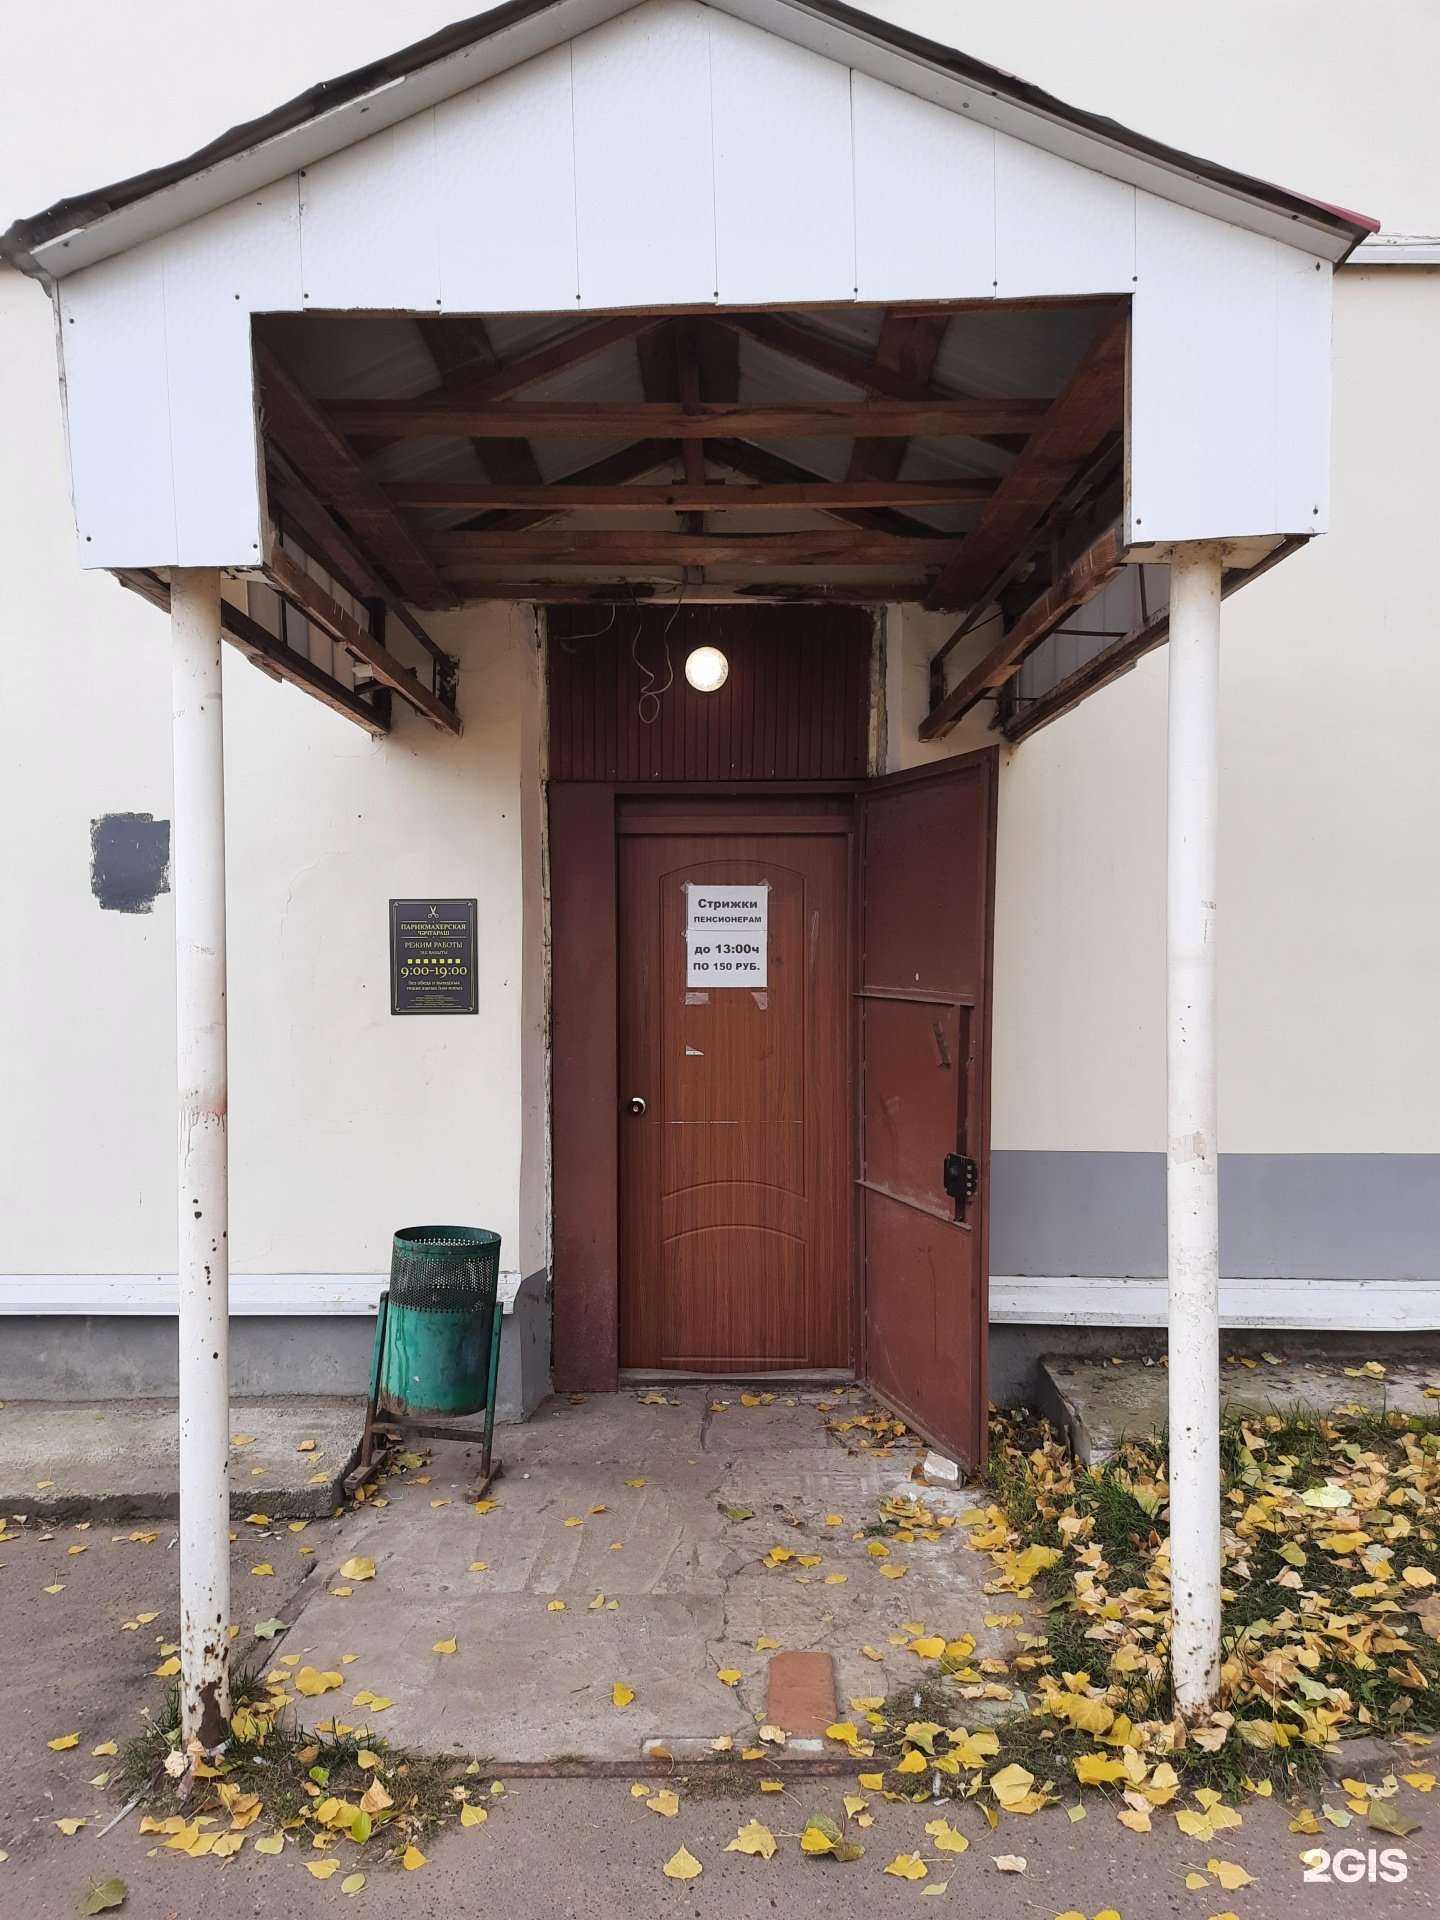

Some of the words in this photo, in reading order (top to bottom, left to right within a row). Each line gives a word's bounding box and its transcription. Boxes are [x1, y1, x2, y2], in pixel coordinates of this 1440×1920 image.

[698, 898, 758, 910] Стрижки
[404, 941, 432, 949] РЕЖИМ
[433, 941, 463, 949] РАБОТЫ
[694, 946, 711, 955] до
[715, 944, 760, 954] 13:00ч
[693, 962, 710, 971] ПО
[713, 962, 732, 971] 150
[735, 962, 760, 971] РУБ.
[400, 966, 467, 979] 9:00-19:00
